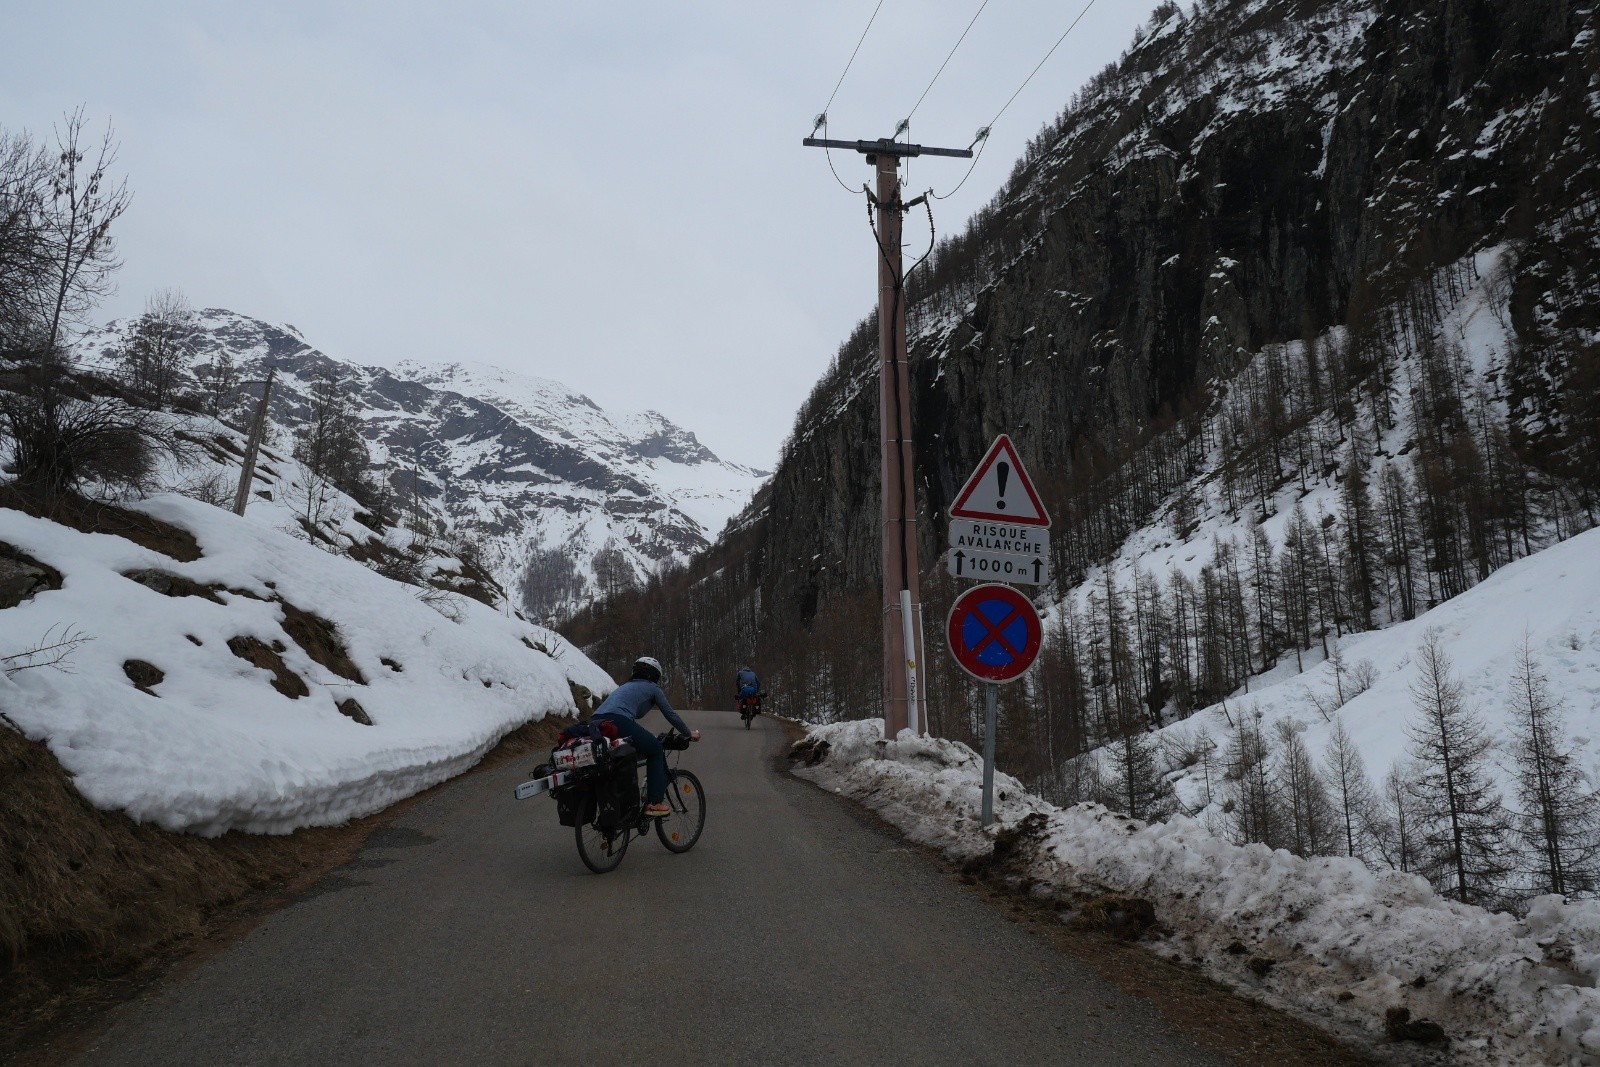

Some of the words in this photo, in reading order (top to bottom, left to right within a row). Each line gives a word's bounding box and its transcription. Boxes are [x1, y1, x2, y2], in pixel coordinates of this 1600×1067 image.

[973, 524, 1027, 540] RISQUE
[958, 535, 1041, 554] AVALANCHE
[969, 558, 1013, 573] 1000
[1018, 567, 1027, 575] m
